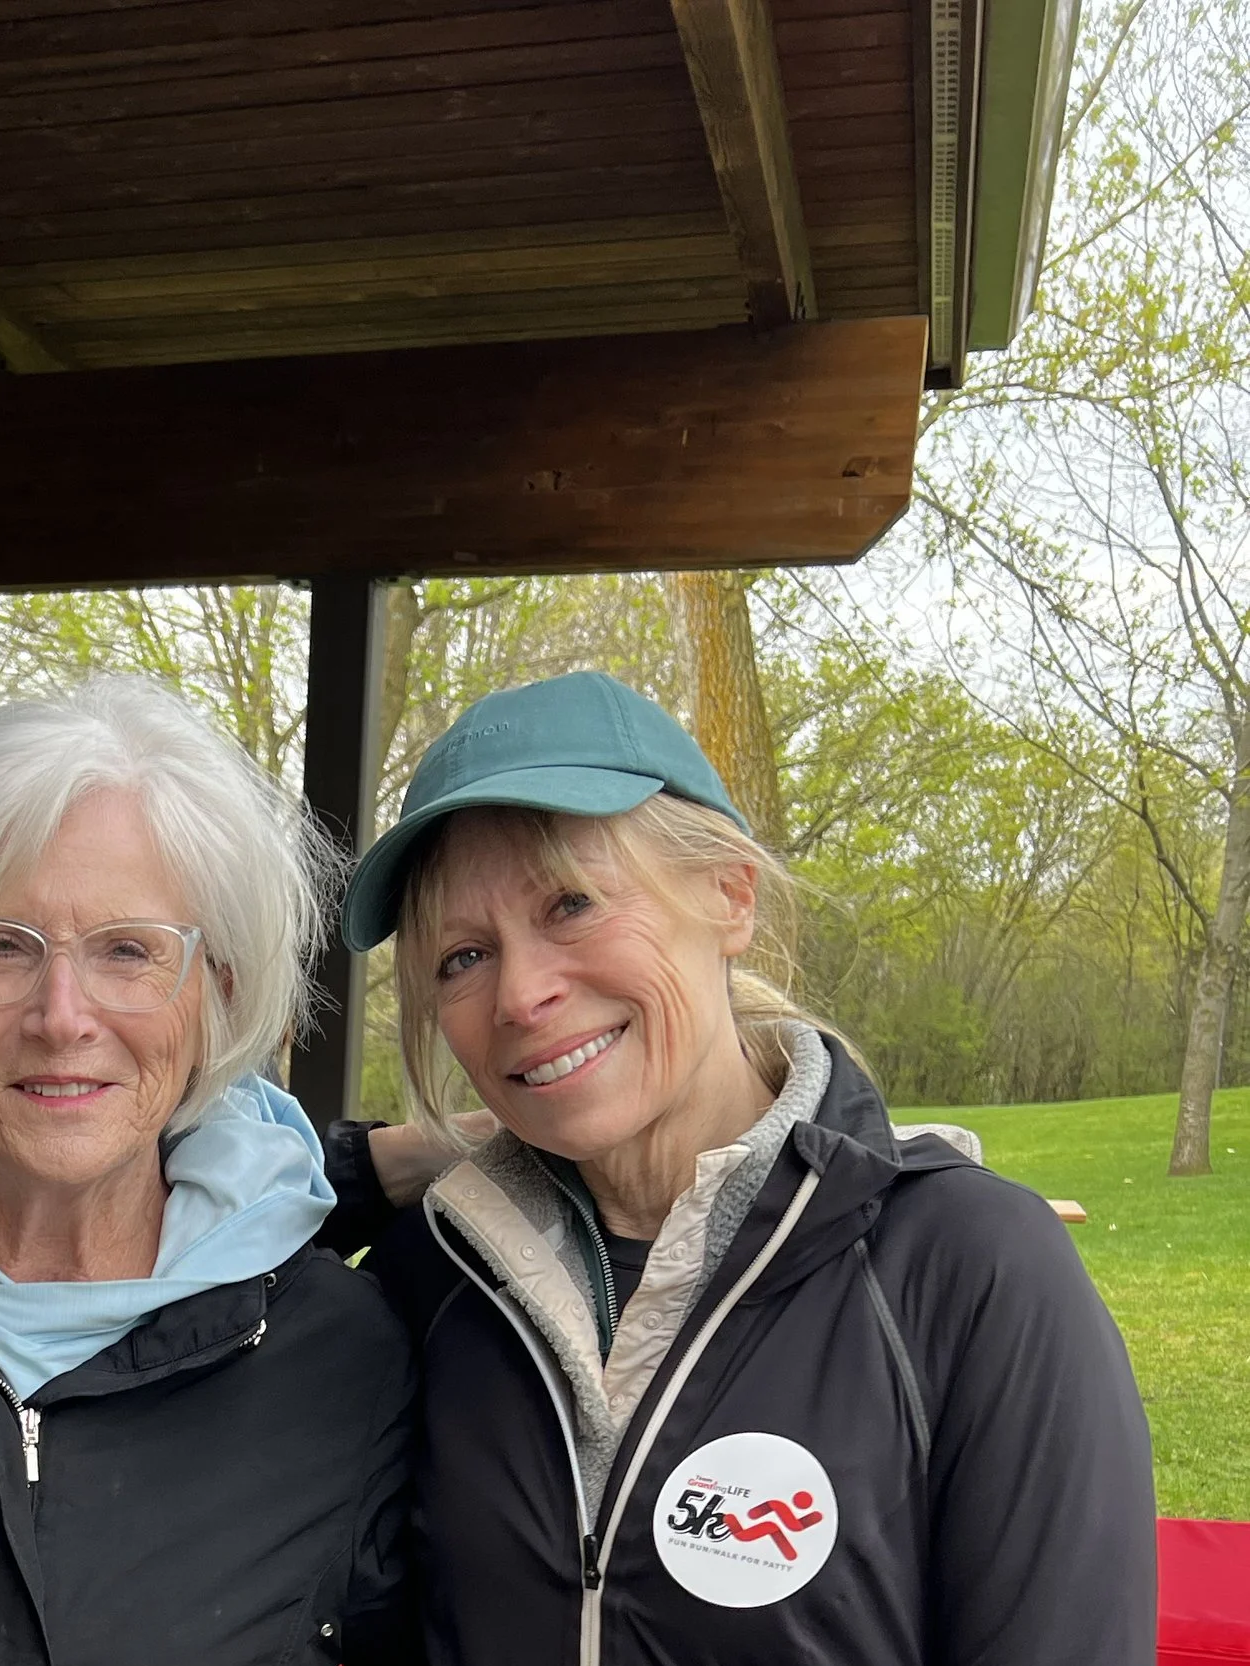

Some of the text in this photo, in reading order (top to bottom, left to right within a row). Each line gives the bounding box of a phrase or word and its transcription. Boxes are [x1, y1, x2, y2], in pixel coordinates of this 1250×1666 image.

[668, 1538, 793, 1573] FUN RUN/WALK FOR PATTY
